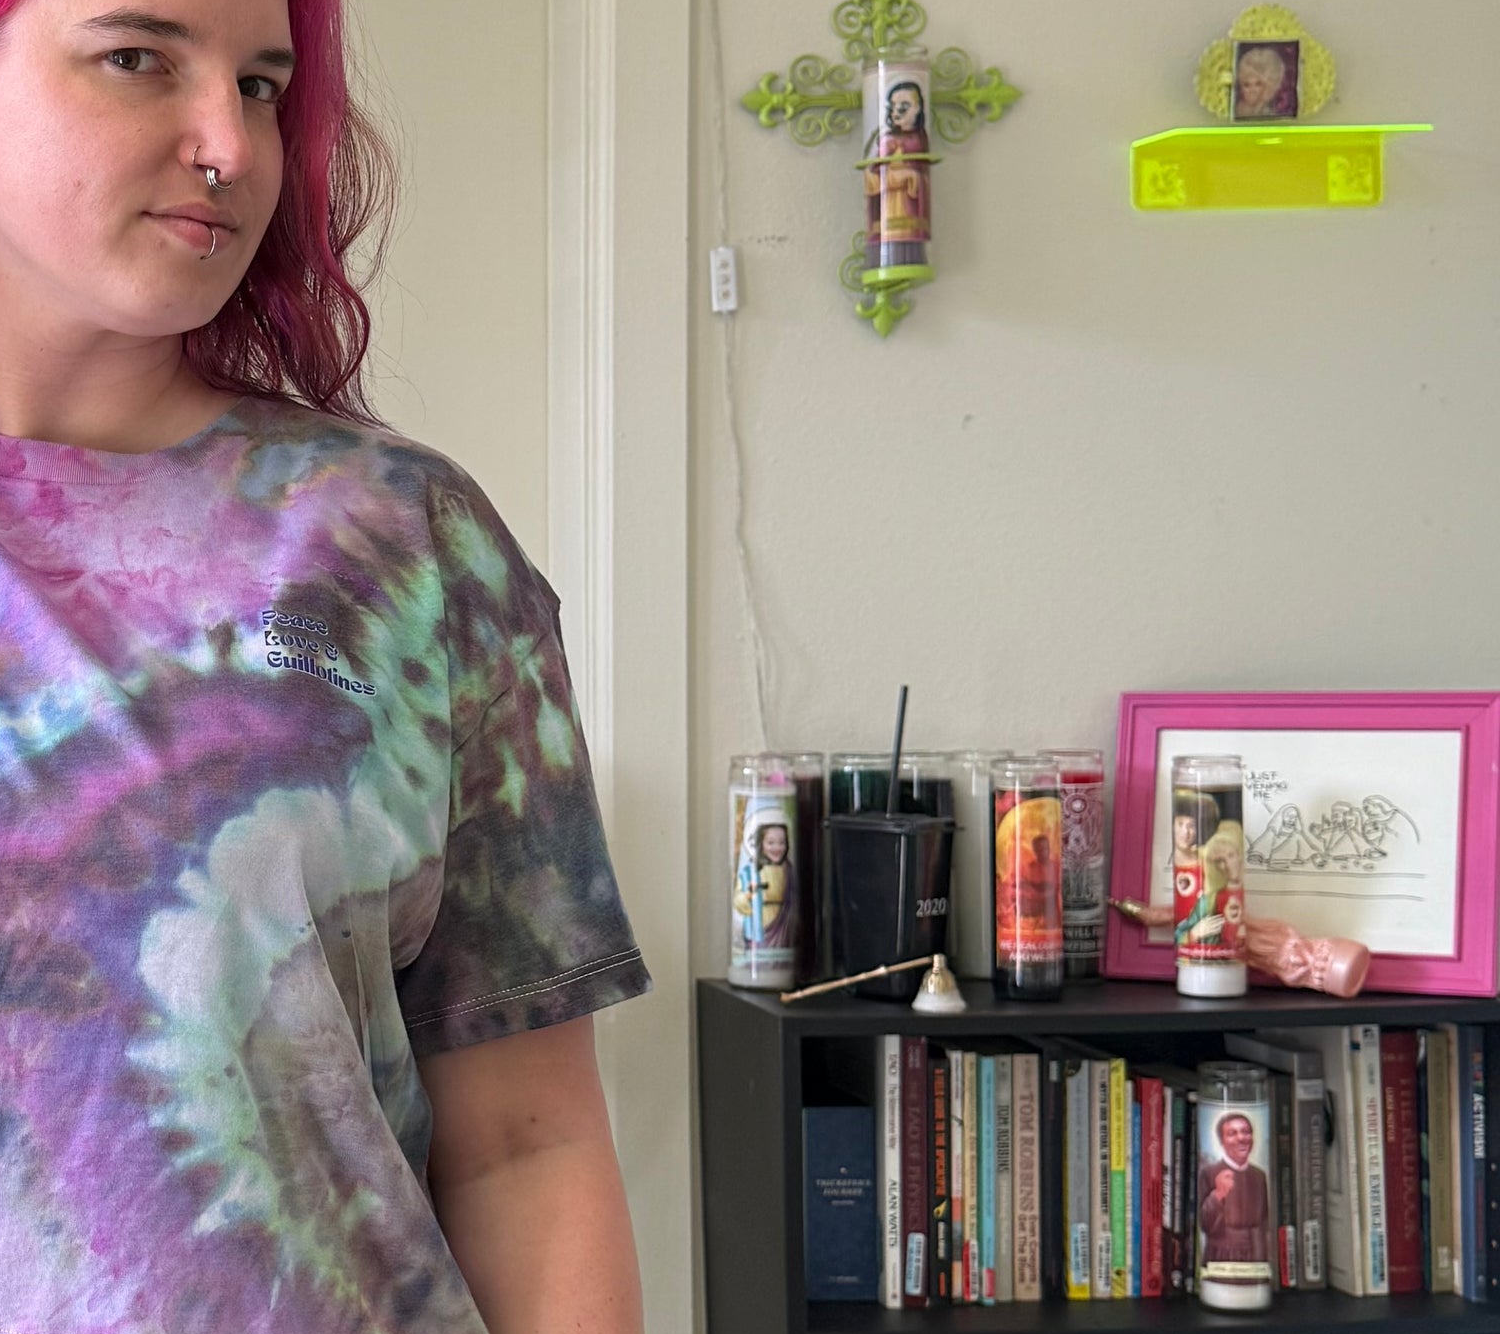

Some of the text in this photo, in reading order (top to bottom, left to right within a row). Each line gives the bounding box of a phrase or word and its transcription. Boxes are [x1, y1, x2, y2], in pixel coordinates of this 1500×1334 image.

[262, 610, 329, 635] Peace
[265, 630, 320, 653] Love
[267, 651, 376, 696] Guillotines
[916, 898, 947, 917] 2020
[1020, 1094, 1034, 1211] TOM ROBBINS
